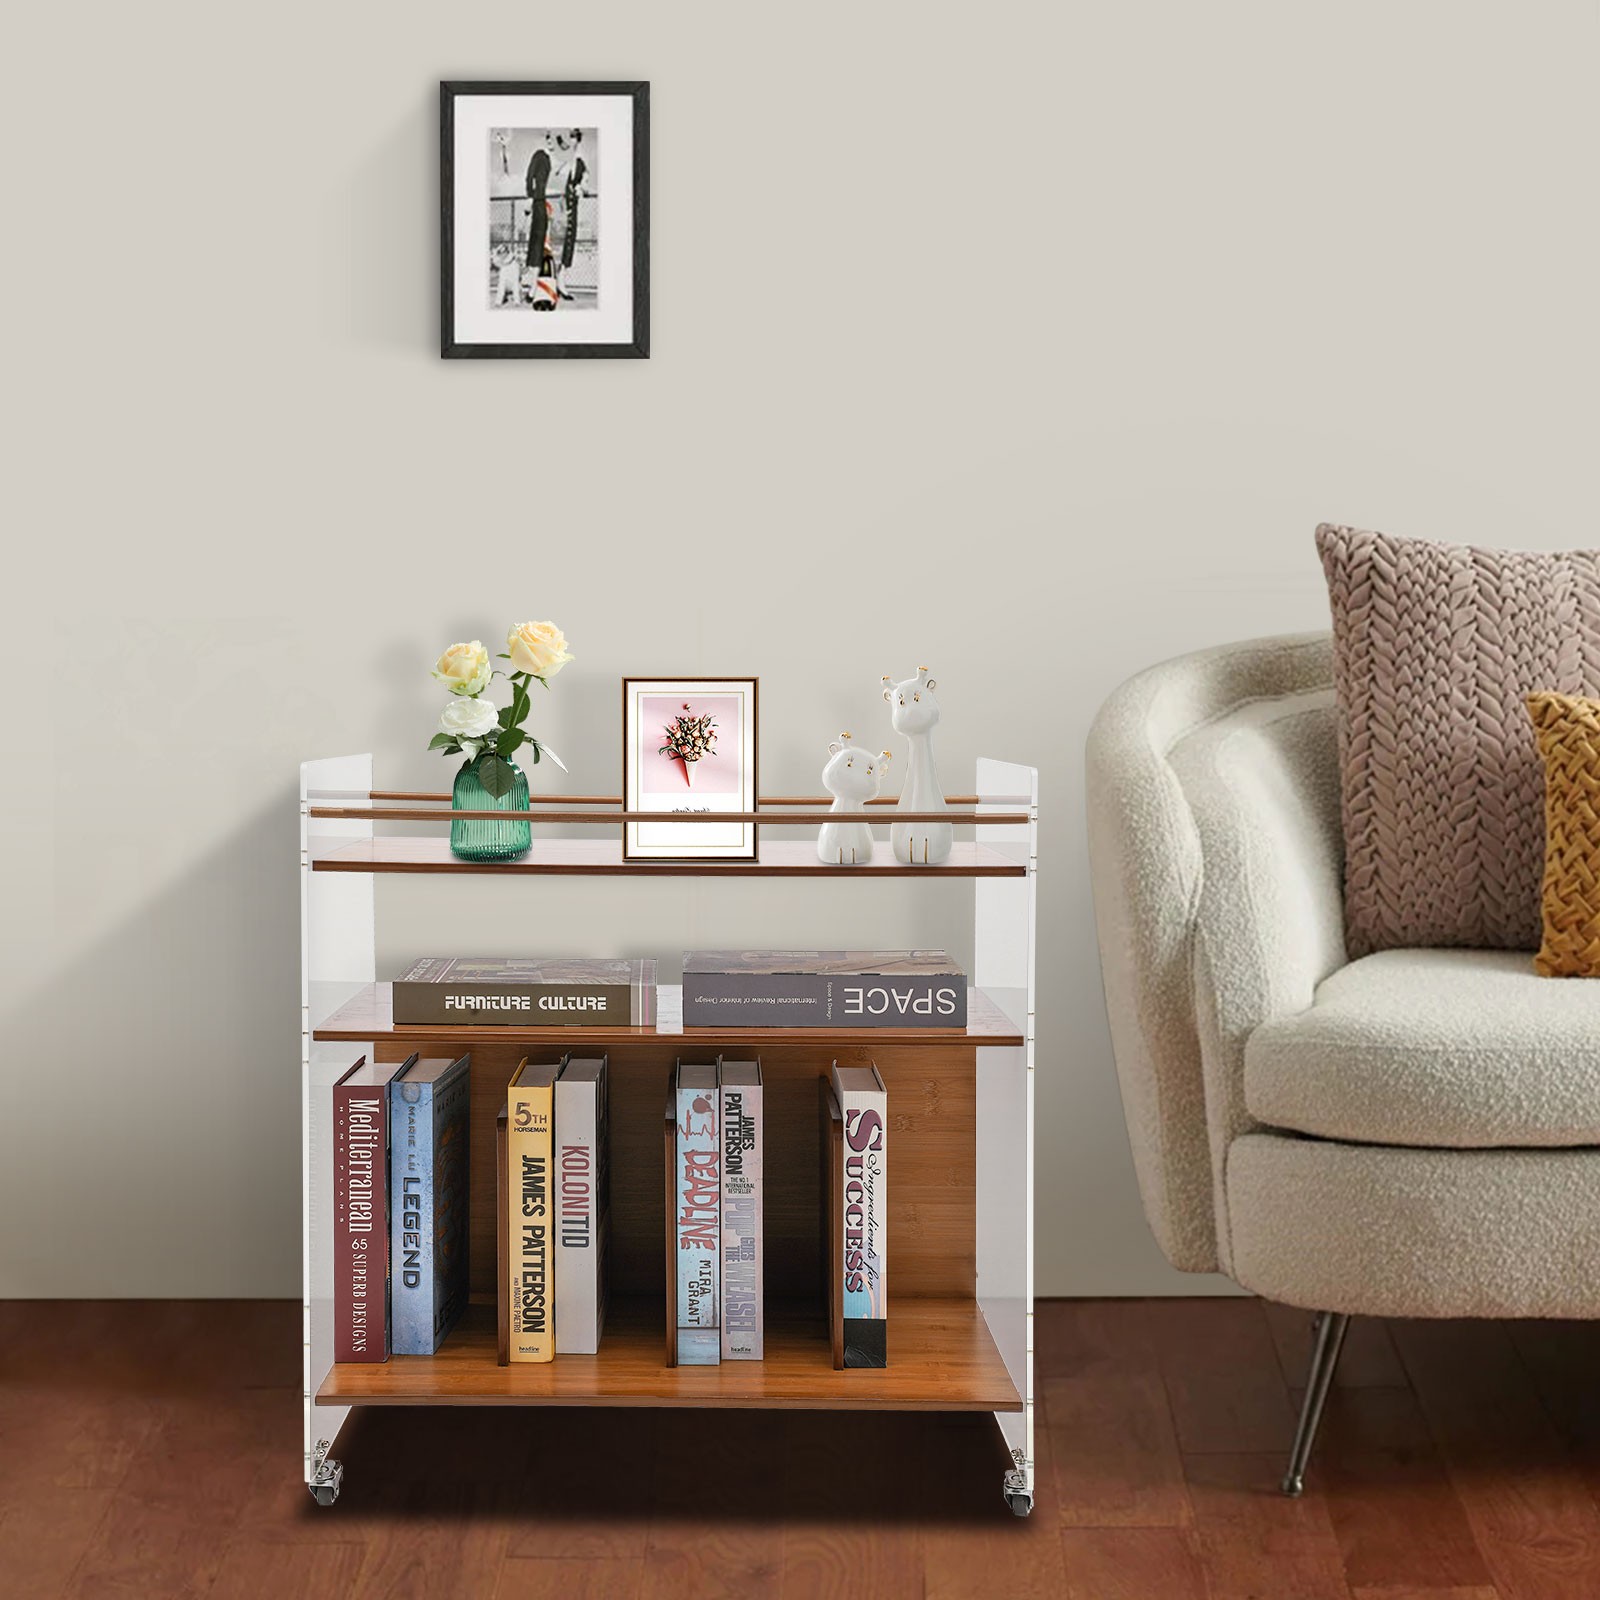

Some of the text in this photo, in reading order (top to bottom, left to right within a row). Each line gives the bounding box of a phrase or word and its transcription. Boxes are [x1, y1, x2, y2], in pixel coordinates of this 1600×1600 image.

[445, 996, 607, 1011] FURNITURE CULTURE
[694, 995, 818, 1005] International Review of Interior Design
[843, 987, 957, 1015] SPACE
[514, 1102, 548, 1126] 5TH
[725, 1093, 742, 1175] PATTERSON
[742, 1115, 755, 1151] JAMES
[407, 1105, 417, 1172] MARIE LU
[348, 1098, 380, 1233] Mediterranean
[561, 1145, 590, 1248] KOLONITID
[680, 1150, 719, 1250] DEADLINE
[845, 1108, 883, 1294] SUCCESS
[402, 1177, 421, 1289] LEGEND
[725, 1198, 756, 1237] POP
[863, 1153, 881, 1291] Ingredients for
[350, 1238, 368, 1251] 65
[522, 1155, 546, 1333] JAMES PATTERSON
[725, 1245, 741, 1262] THE
[740, 1236, 755, 1260] GOES
[513, 1287, 522, 1309] MAXINE
[699, 1261, 712, 1298] MIRA
[725, 1262, 756, 1335] WEASEL
[352, 1253, 367, 1352] SUPERB DESIGNS
[513, 1310, 522, 1333] PAETRO
[688, 1281, 700, 1325] GRANT
